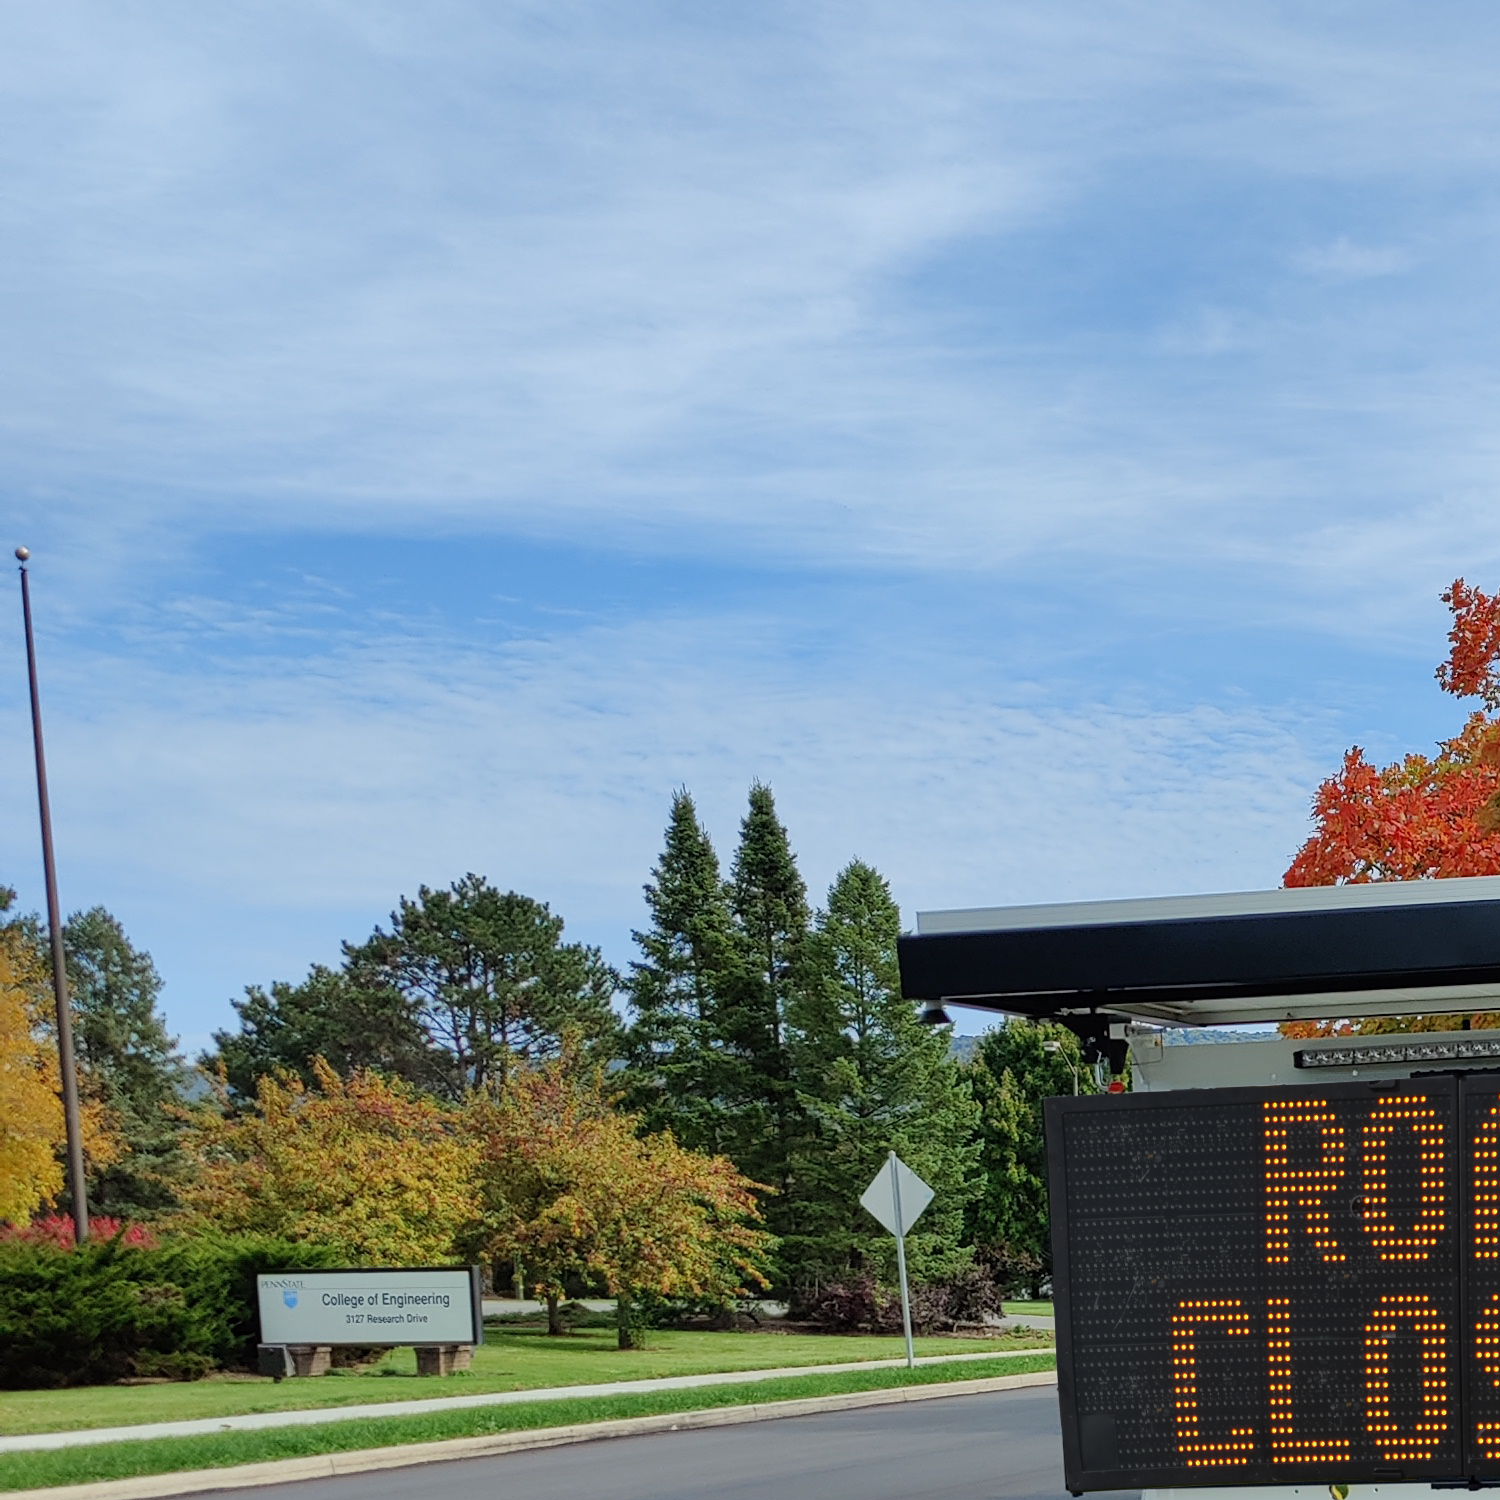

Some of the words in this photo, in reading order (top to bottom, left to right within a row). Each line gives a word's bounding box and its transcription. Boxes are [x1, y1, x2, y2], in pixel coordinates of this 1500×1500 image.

[322, 1293, 364, 1308] College
[368, 1293, 379, 1305] of
[382, 1292, 450, 1308] Engineering
[346, 1314, 364, 1324] 3127
[367, 1314, 404, 1323] Research
[407, 1313, 428, 1323] Drive
